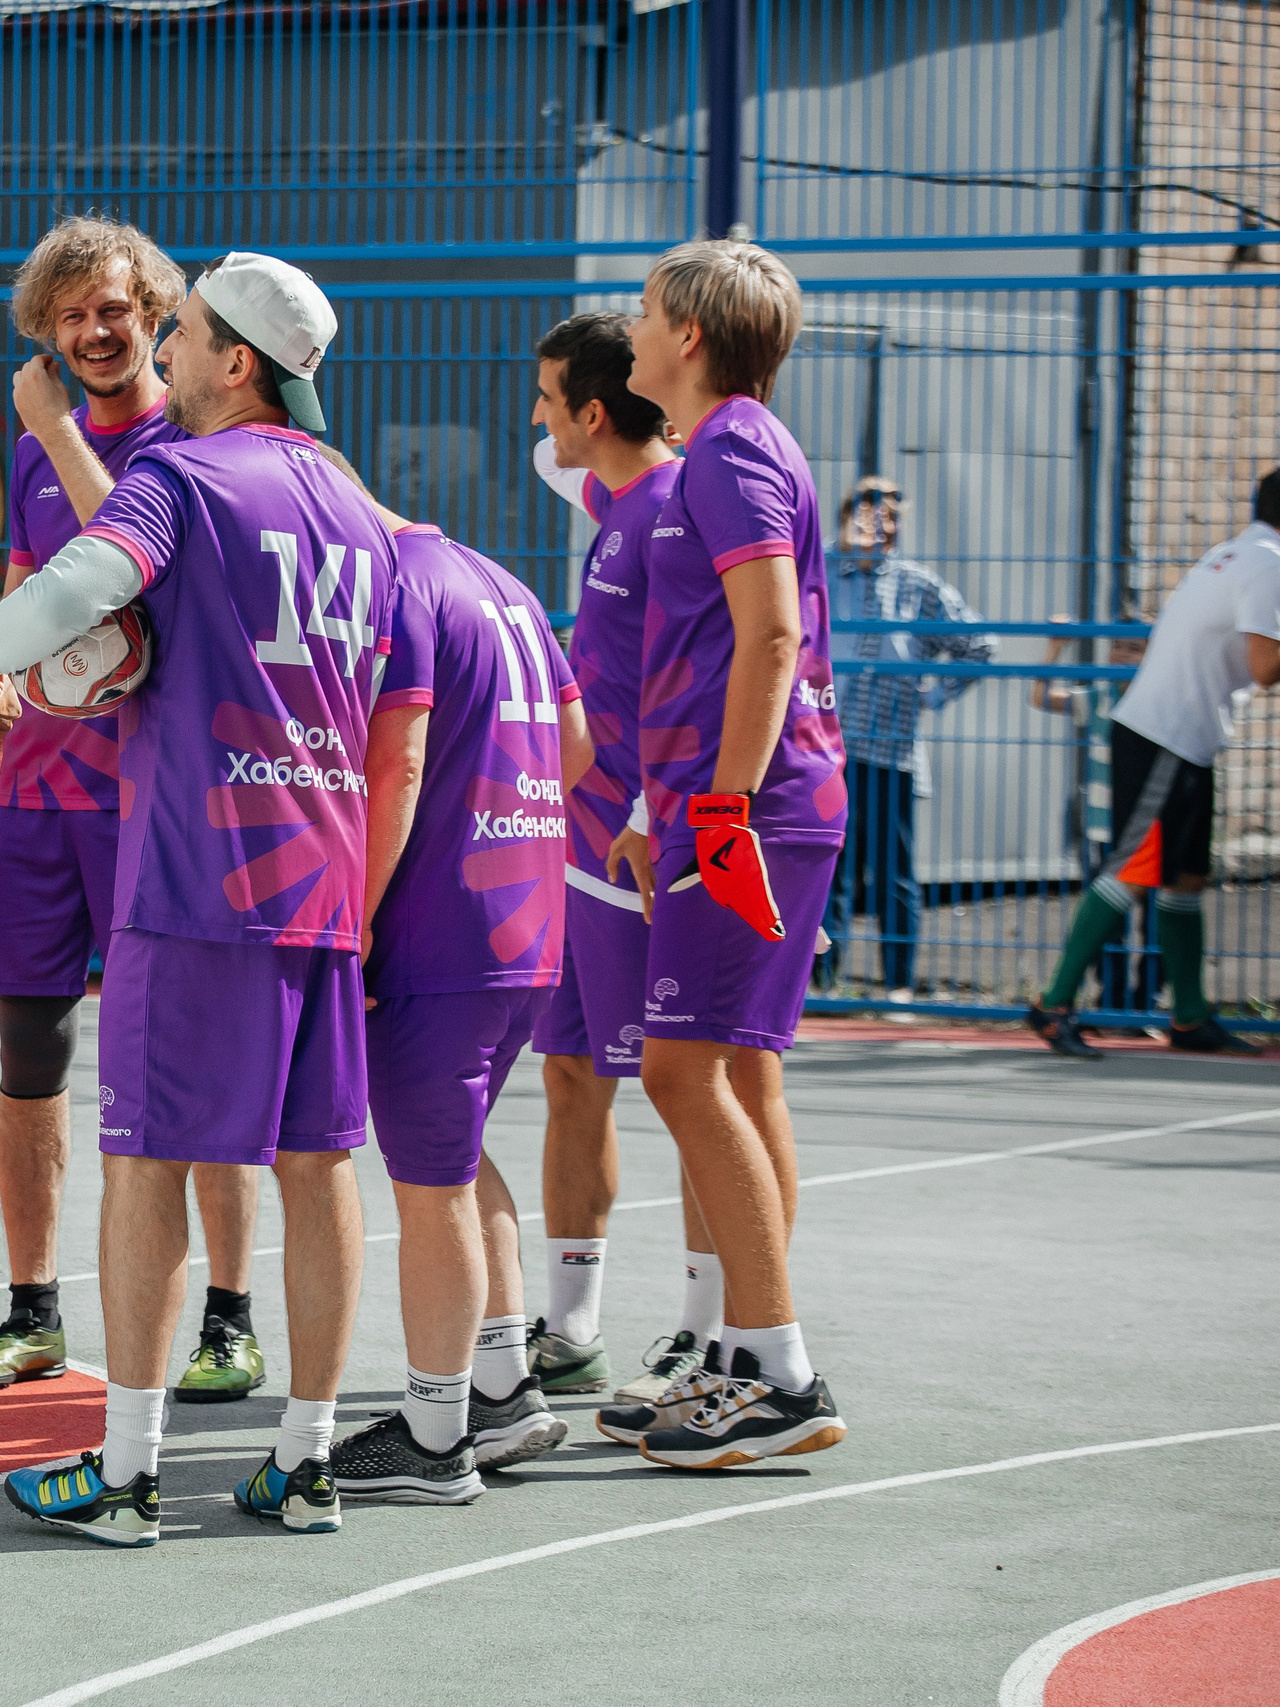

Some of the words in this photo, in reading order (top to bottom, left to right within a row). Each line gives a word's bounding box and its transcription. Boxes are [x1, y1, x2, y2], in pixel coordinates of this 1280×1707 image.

[255, 529, 374, 679] 14
[478, 599, 559, 724] 11
[285, 717, 347, 758] Фон
[516, 770, 564, 806] Фонд
[472, 808, 567, 841] Хабенск
[695, 806, 744, 816] DEMIX
